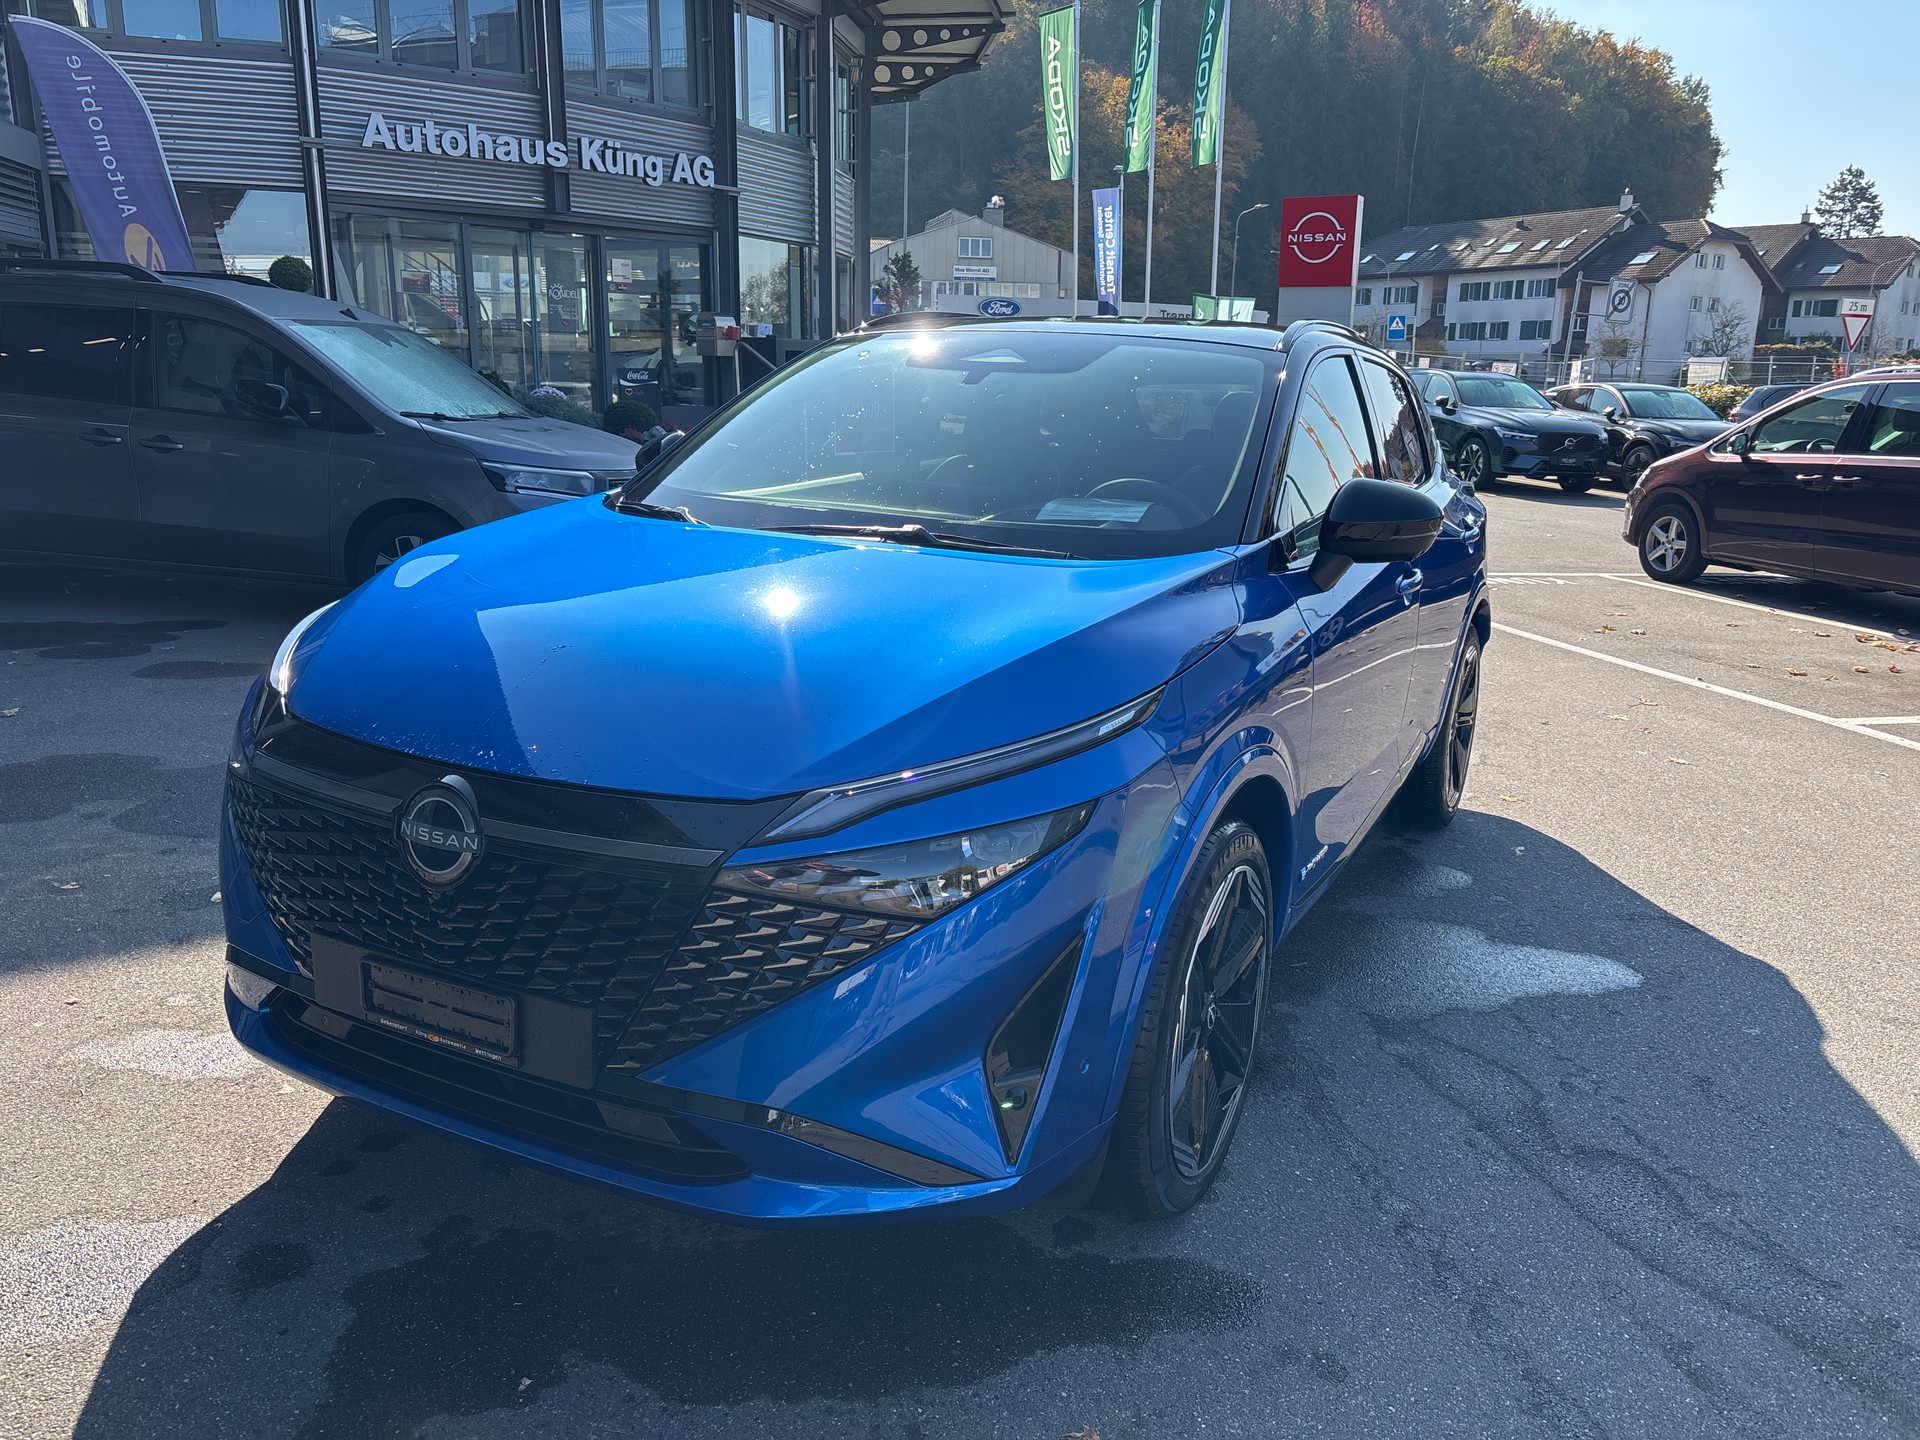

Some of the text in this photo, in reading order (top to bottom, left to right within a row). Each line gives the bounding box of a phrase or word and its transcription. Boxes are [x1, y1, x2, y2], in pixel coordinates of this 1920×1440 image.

[361, 112, 715, 187] Autohaus Küng AG
[1287, 232, 1347, 243] NISSAN
[988, 301, 1014, 314] Ford
[1848, 301, 1859, 311] 25
[400, 820, 478, 850] NISSAN
[439, 1037, 467, 1050] Automobile
